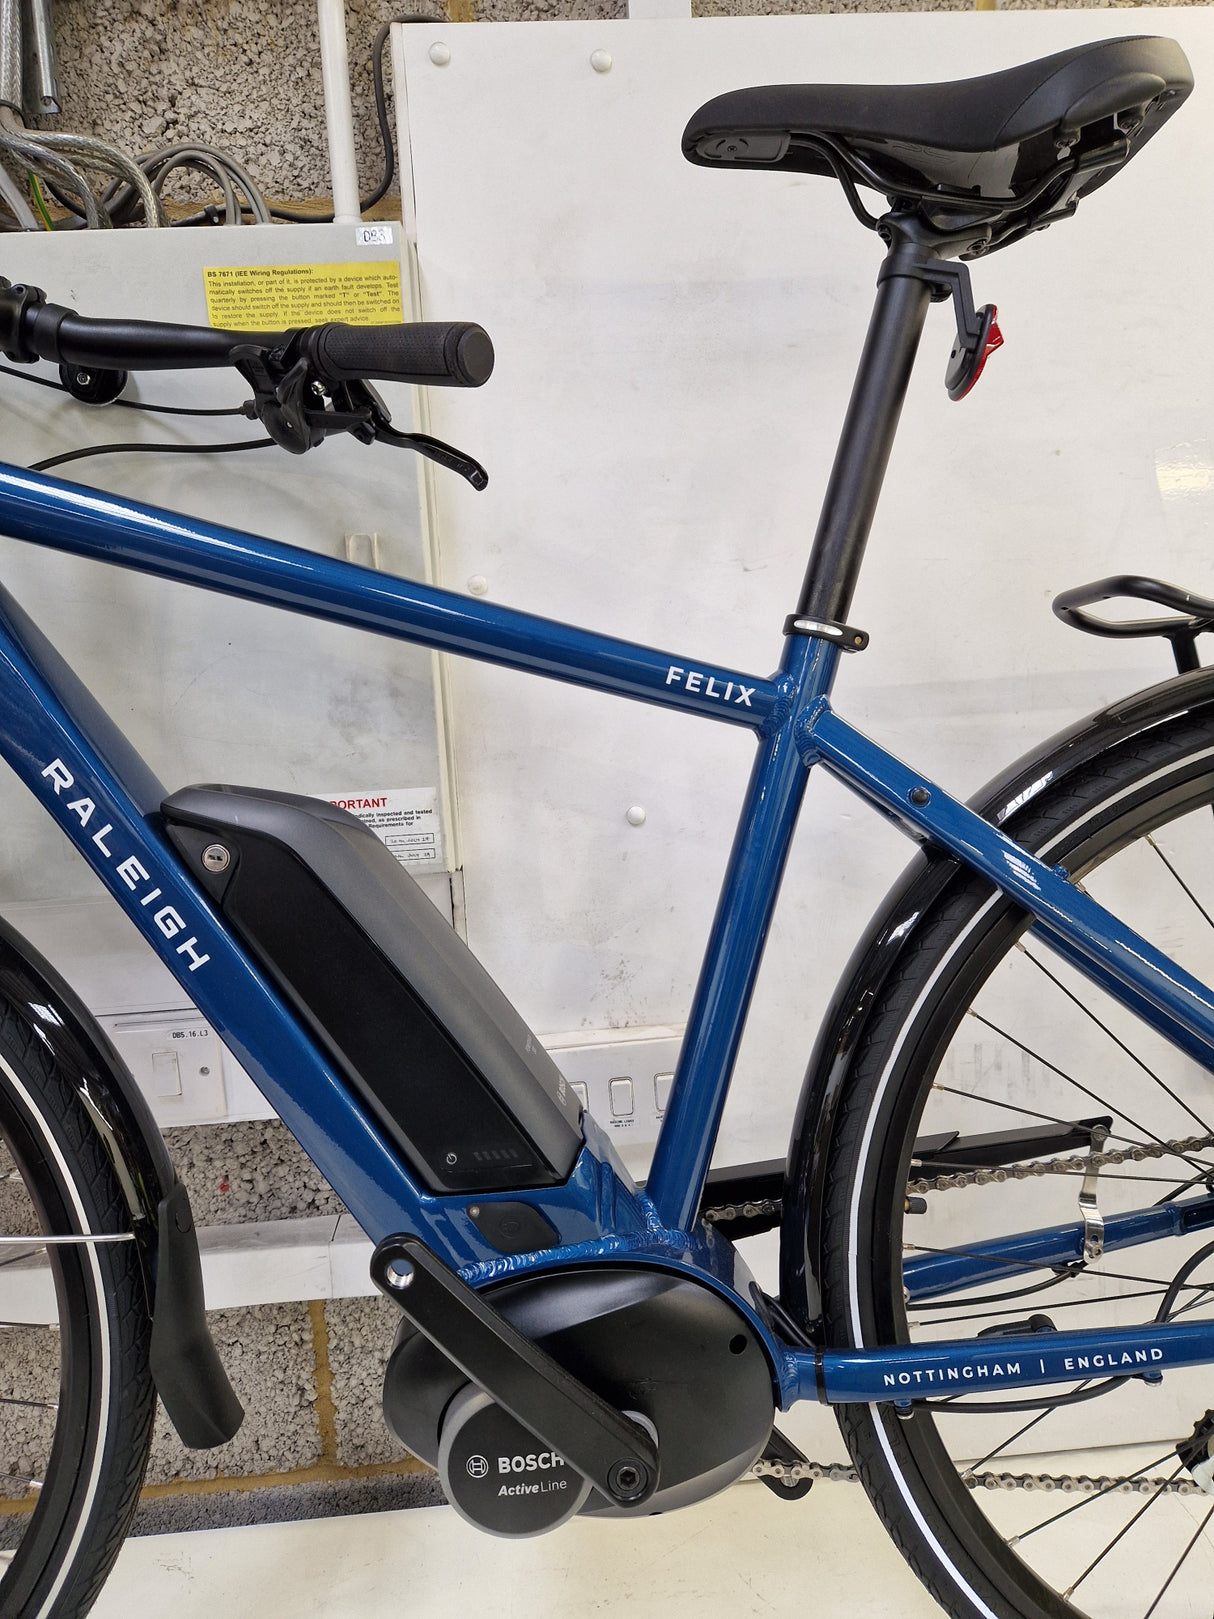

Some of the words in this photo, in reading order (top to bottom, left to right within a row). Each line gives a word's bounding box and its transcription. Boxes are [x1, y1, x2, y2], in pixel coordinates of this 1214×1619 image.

[235, 270, 248, 278] (IEE
[272, 268, 313, 276] Regulations):
[301, 277, 328, 285] protected
[665, 665, 756, 707] FELIX
[329, 797, 388, 810] ORTANT
[41, 758, 210, 972] RALEIGH
[172, 1030, 209, 1039] DB5.16.L3
[883, 1362, 1021, 1386] NOTTINGHAM
[1064, 1348, 1163, 1370] ENGLAND
[497, 1452, 565, 1474] BOSCH
[497, 1480, 568, 1497] ActiveLine
